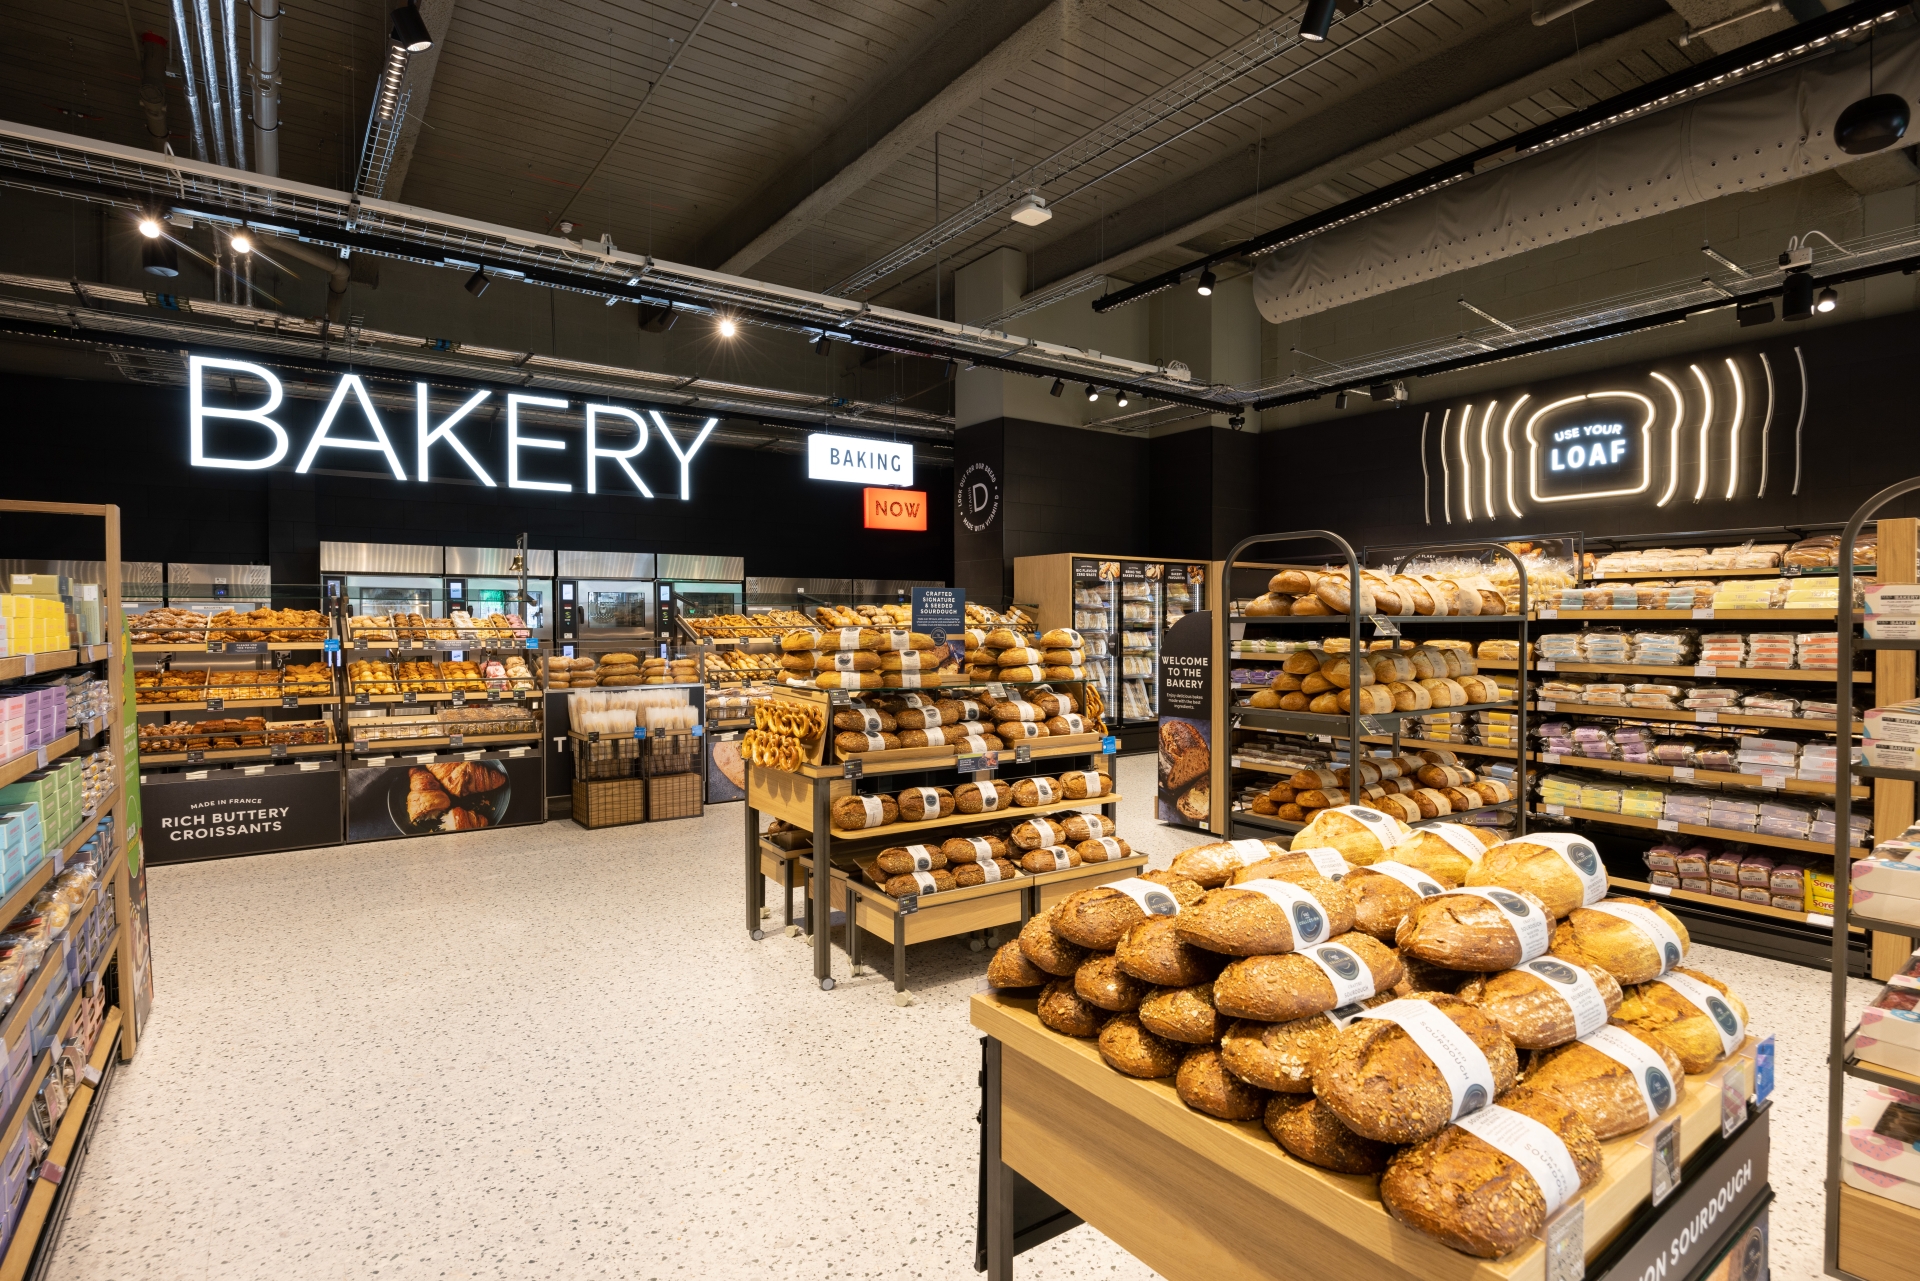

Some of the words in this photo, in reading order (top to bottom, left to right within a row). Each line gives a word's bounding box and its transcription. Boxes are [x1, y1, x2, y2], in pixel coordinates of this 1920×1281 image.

[189, 354, 719, 501] BAKERY
[1554, 427, 1580, 442] USE
[1583, 424, 1622, 435] YOUR
[830, 447, 901, 472] BAKING
[1551, 439, 1626, 470] LOAF
[984, 465, 997, 483] BREAD
[973, 483, 989, 512] D
[875, 500, 920, 518] NOW
[963, 517, 974, 531] MADE
[974, 523, 985, 532] WITH
[985, 502, 998, 526] VITAMIN
[1162, 656, 1208, 666] WELCOME
[1168, 668, 1180, 676] TO
[1183, 668, 1201, 677] THE
[1166, 679, 1203, 689] BAKERY
[190, 801, 215, 810] MADE
[162, 814, 205, 828] RICH
[212, 807, 289, 823] BUTTERY
[170, 821, 282, 841] CROISSANTS
[1813, 879, 1834, 889] Sore
[1813, 900, 1834, 910] Sore
[1521, 921, 1542, 932] SOURDOUGH
[1344, 986, 1369, 998] SOURDOUGH
[1571, 988, 1592, 1001] SOURDOUGH
[1420, 1021, 1469, 1080] SOURDOUGH
[1436, 1029, 1466, 1062] CRAFTED
[1590, 1031, 1644, 1063] OURDOUGH
[1524, 1144, 1564, 1200] SOURDOU
[1670, 1159, 1751, 1266] SOURDOUGH
